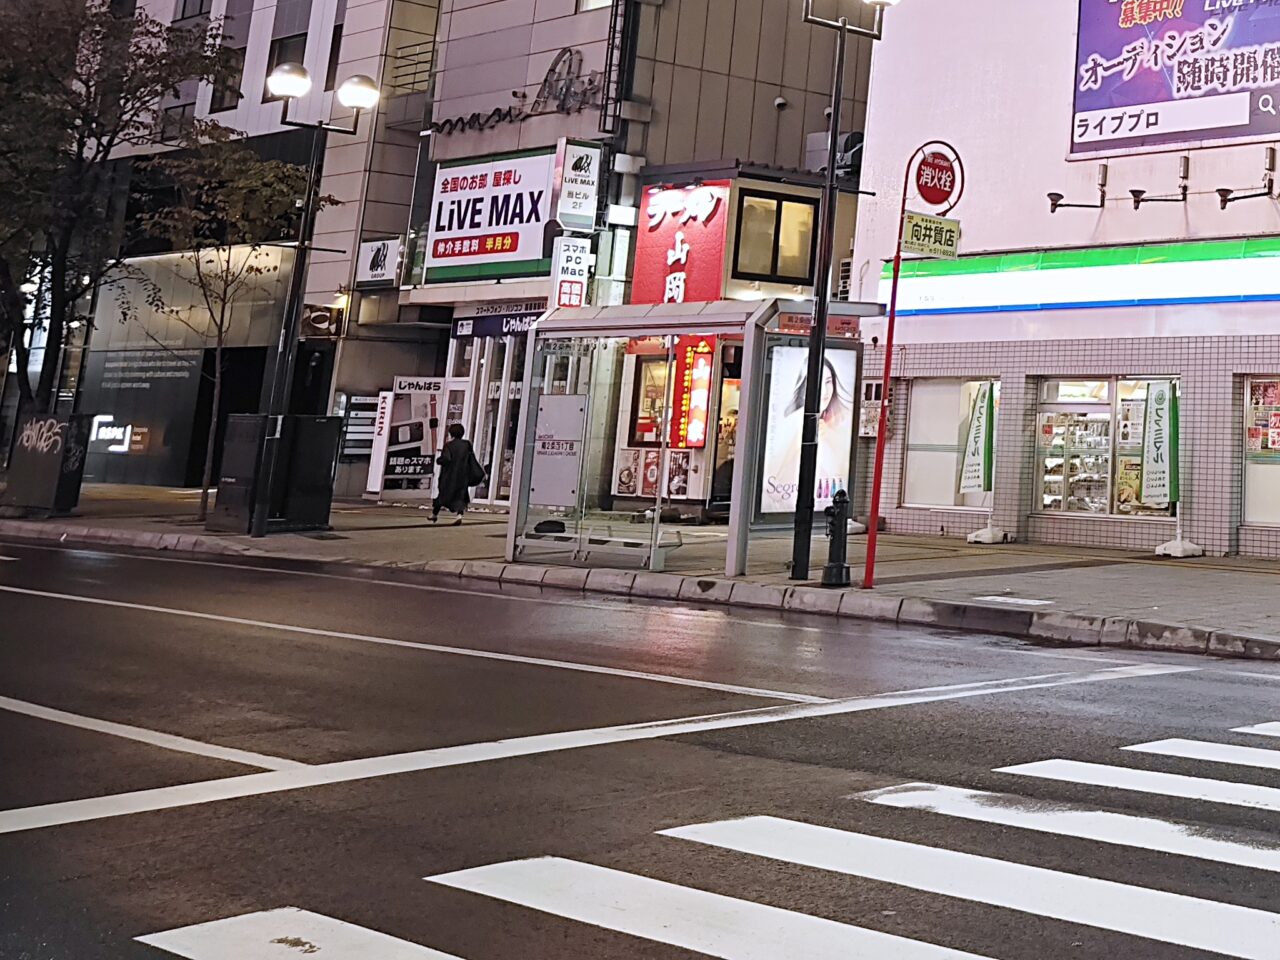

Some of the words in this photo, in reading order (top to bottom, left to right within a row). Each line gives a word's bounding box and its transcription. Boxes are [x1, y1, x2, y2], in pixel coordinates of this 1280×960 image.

[1080, 16, 1233, 90] オーディション
[1076, 112, 1160, 138] ライブプロ
[580, 178, 596, 187] MAX
[919, 165, 953, 192] 消火栓
[487, 190, 545, 228] MAX
[910, 221, 955, 248] 向井質店
[563, 244, 588, 254] スマホ
[565, 256, 583, 266] PC
[561, 267, 585, 277] Mac
[377, 396, 388, 436] KIRIN
[766, 475, 798, 500] Segr
